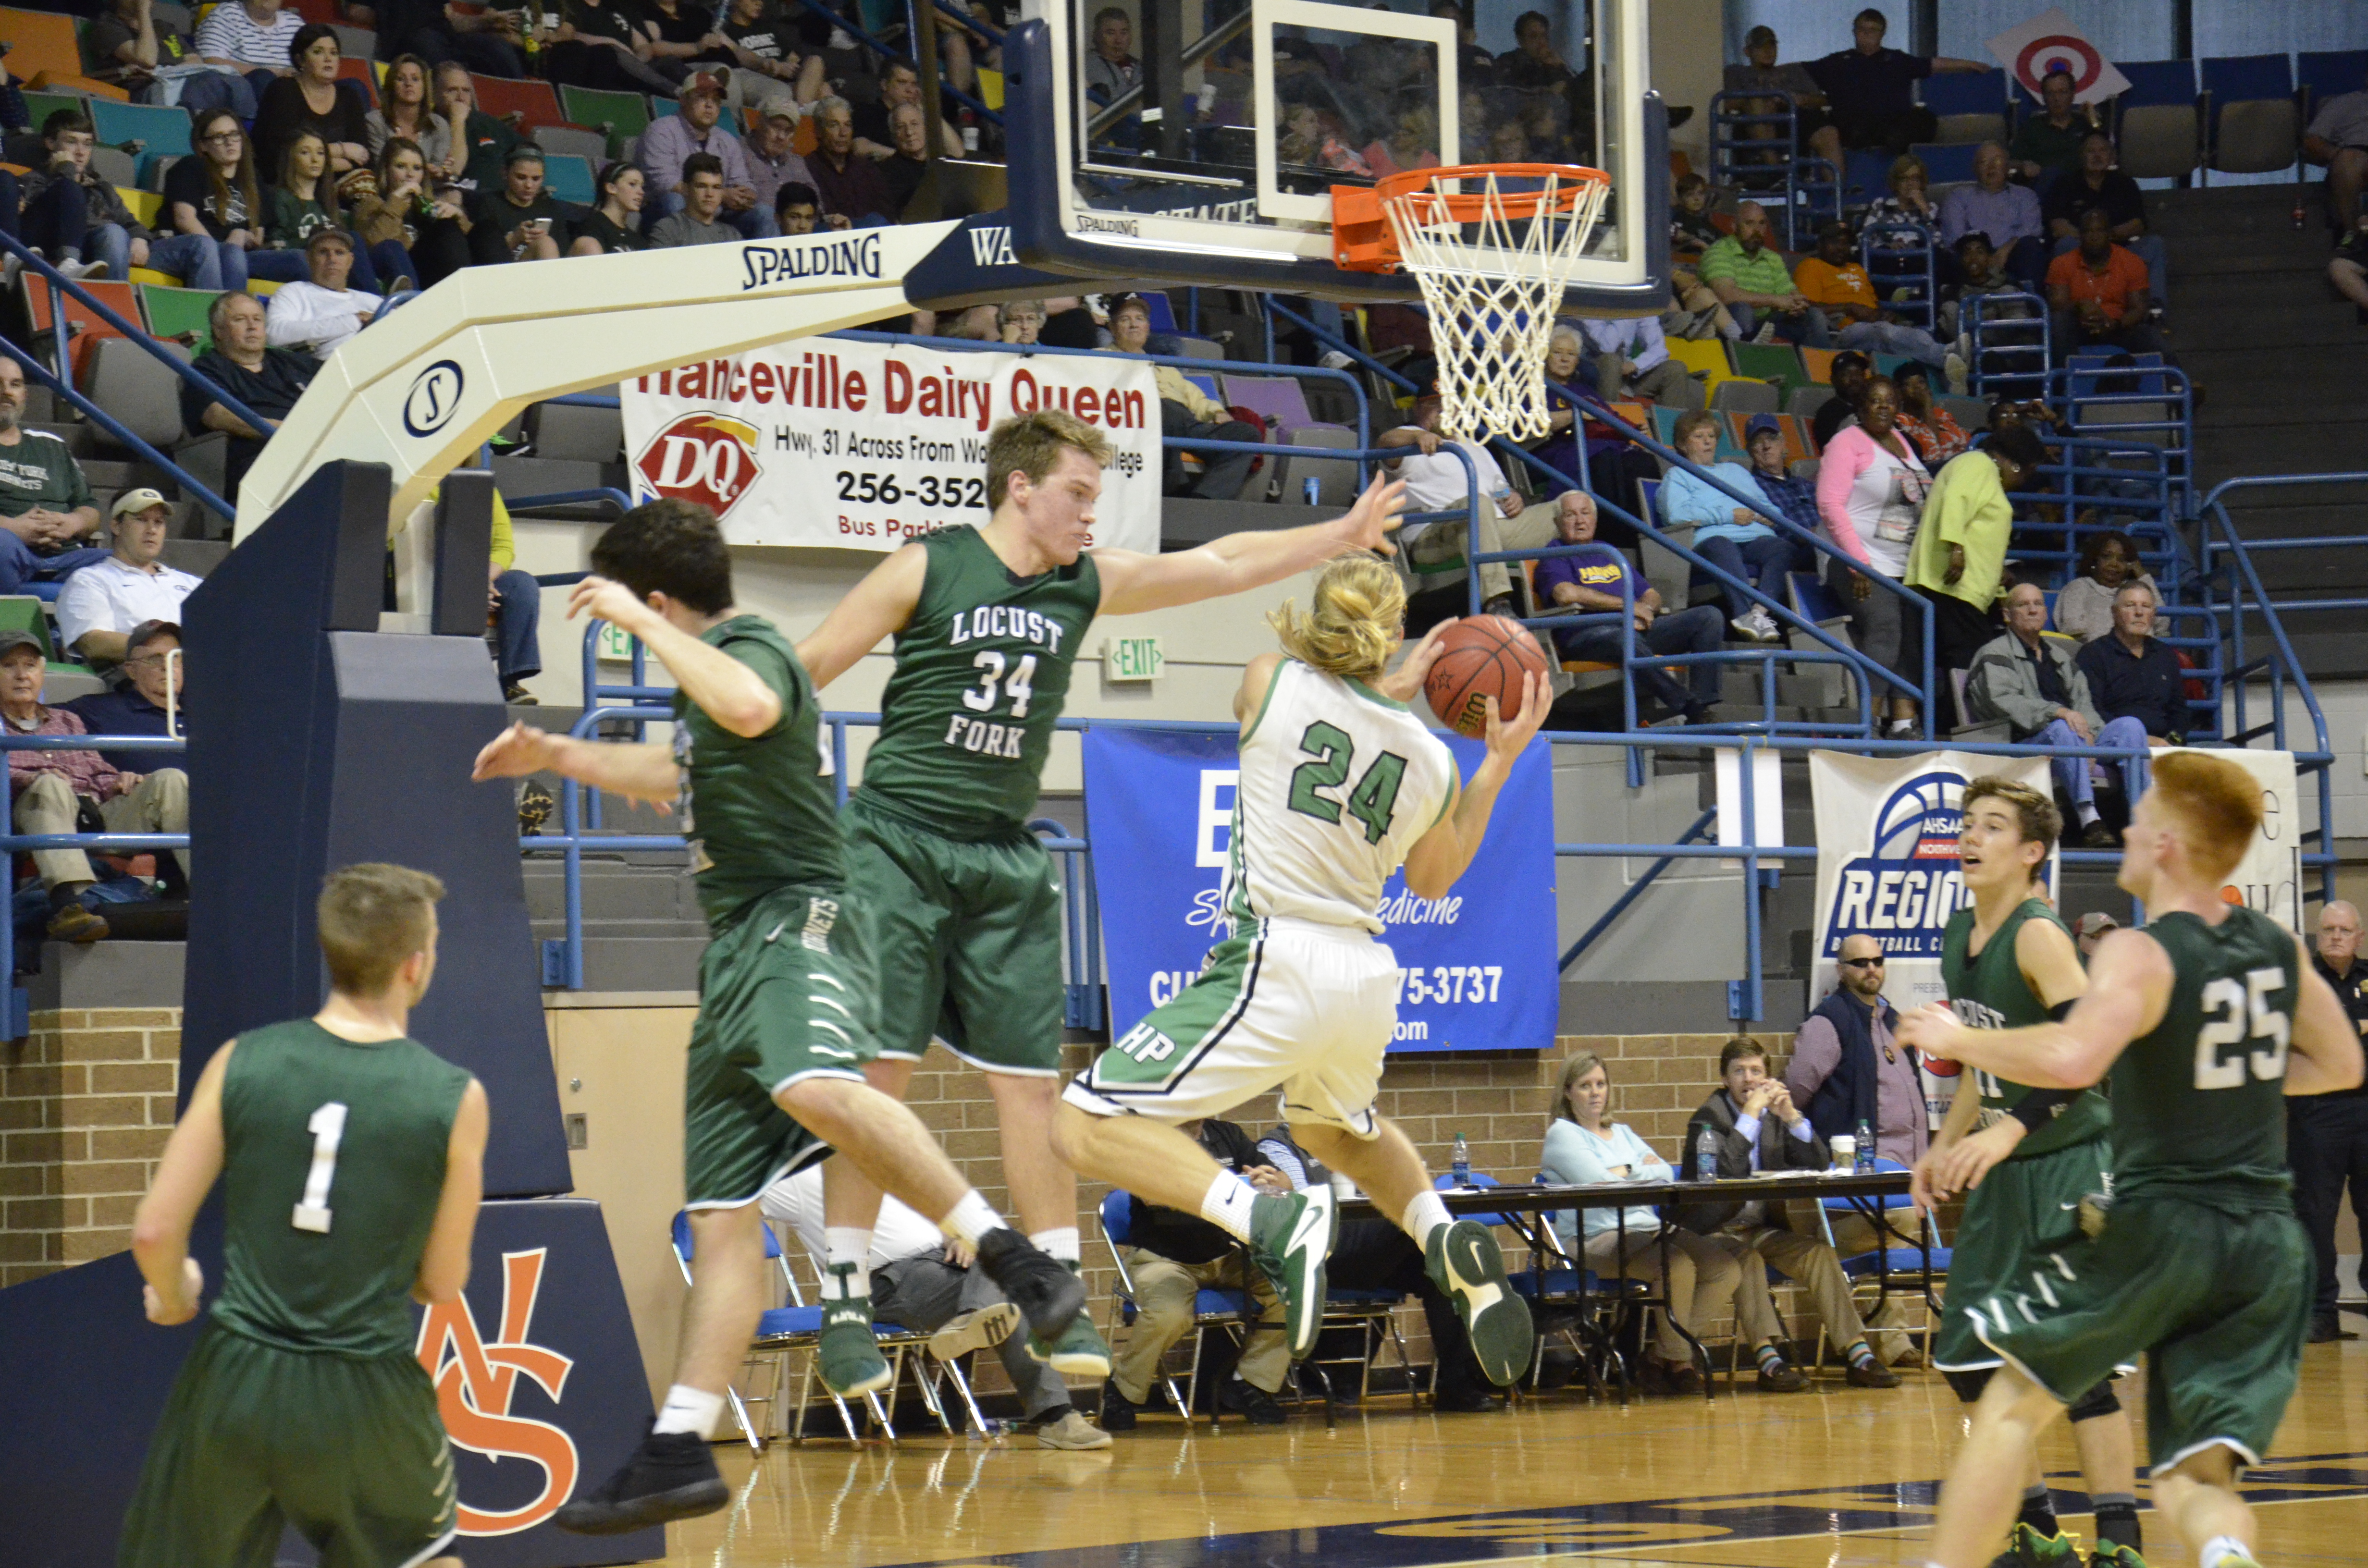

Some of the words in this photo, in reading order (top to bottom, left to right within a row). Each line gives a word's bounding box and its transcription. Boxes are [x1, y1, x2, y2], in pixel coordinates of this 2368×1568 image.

[1077, 215, 1139, 237] SPALDING
[742, 233, 880, 290] SPALDING
[968, 226, 1019, 266] WA
[885, 359, 991, 431] Dairy
[1011, 368, 1144, 429] Queen
[775, 425, 816, 459] Hwy.
[823, 429, 839, 455] 31
[847, 431, 904, 460] Across
[910, 435, 955, 462] From
[654, 435, 740, 502] DQ
[837, 471, 985, 508] 256-352
[838, 515, 876, 536] Bus
[950, 605, 1063, 654] LOCUST
[1121, 639, 1155, 675] EXIT
[962, 651, 1037, 718] 34
[944, 714, 1026, 759] FORK
[1287, 720, 1408, 846] 24
[1922, 818, 1964, 833] AHSAA
[1919, 844, 1961, 855] NORTHWE
[1374, 887, 1463, 925] edicine
[1395, 966, 1503, 1005] 75-3737
[1913, 983, 1947, 993] PRESEN
[1115, 1022, 1176, 1064] HP
[1394, 1021, 1429, 1041] om
[2193, 967, 2290, 1090] 25
[291, 1102, 349, 1234] 1
